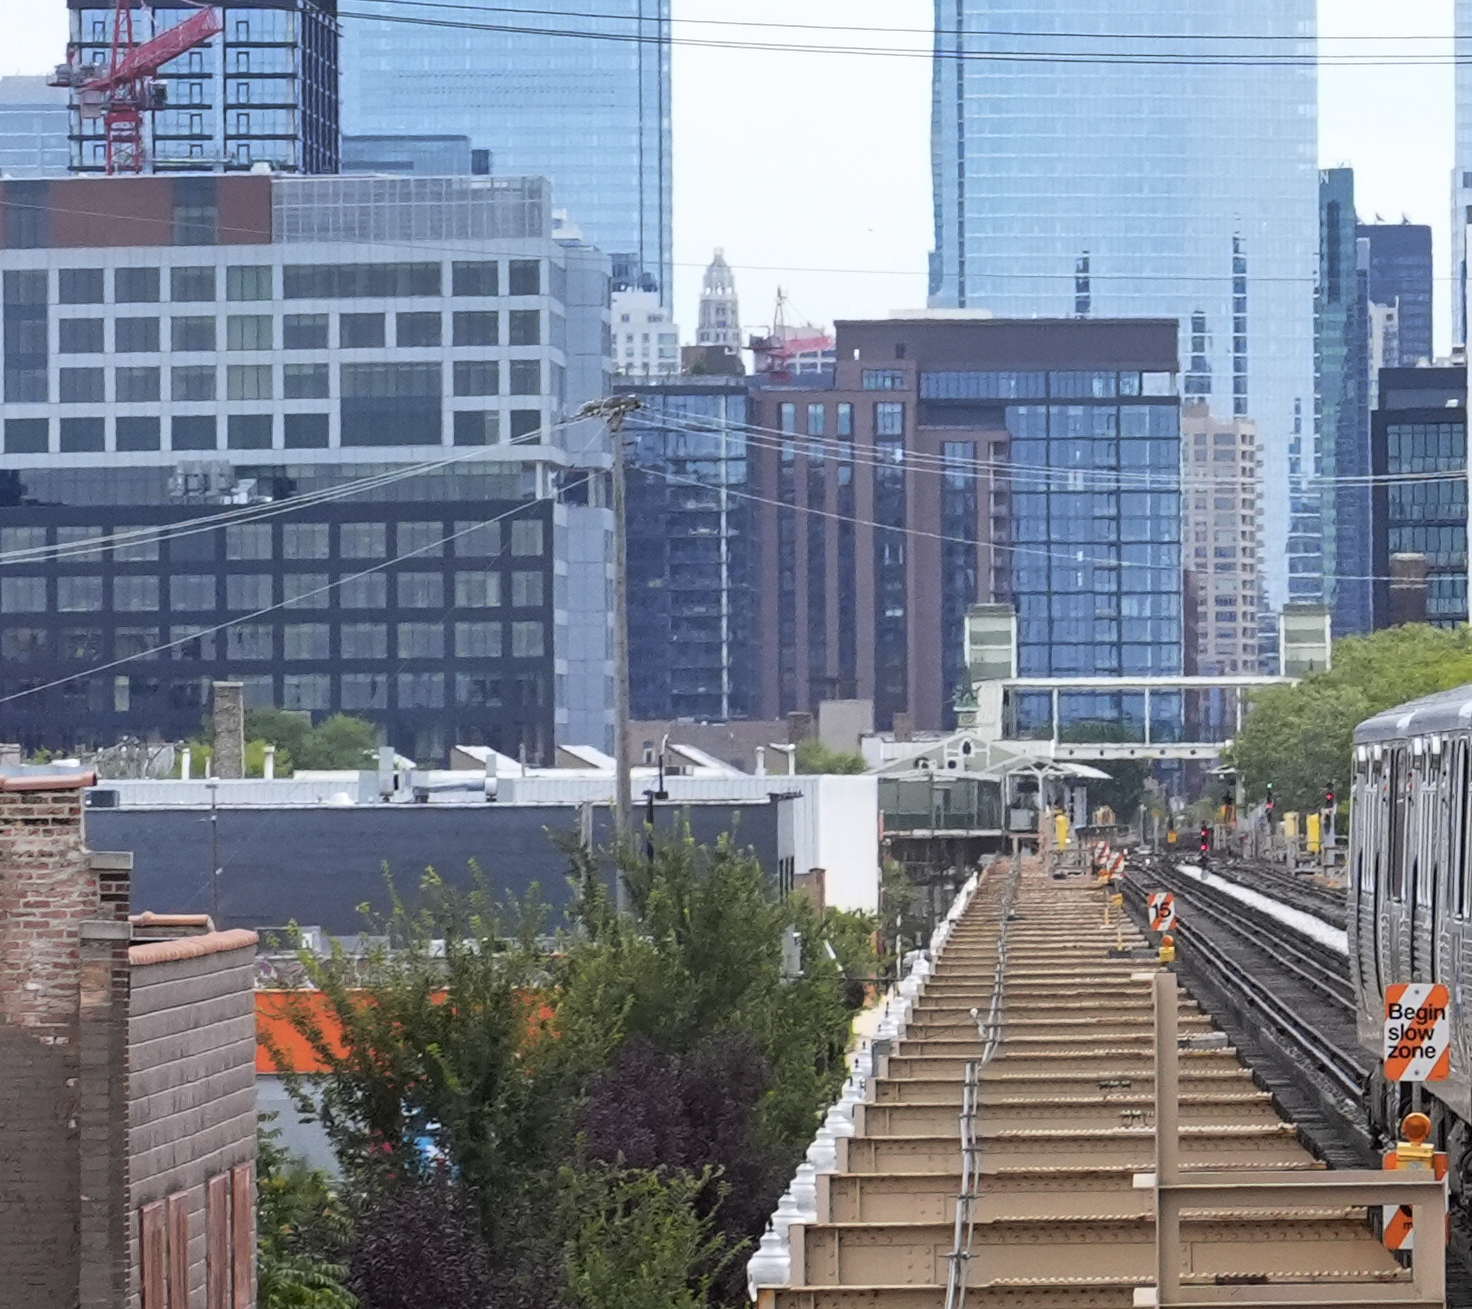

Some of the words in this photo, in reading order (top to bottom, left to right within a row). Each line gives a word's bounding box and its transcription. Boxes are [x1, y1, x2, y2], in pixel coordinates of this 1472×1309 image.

[1151, 901, 1172, 919] 15
[1388, 1003, 1446, 1026] Begin
[1388, 1023, 1436, 1042] slow
[1387, 1044, 1437, 1059] zone
